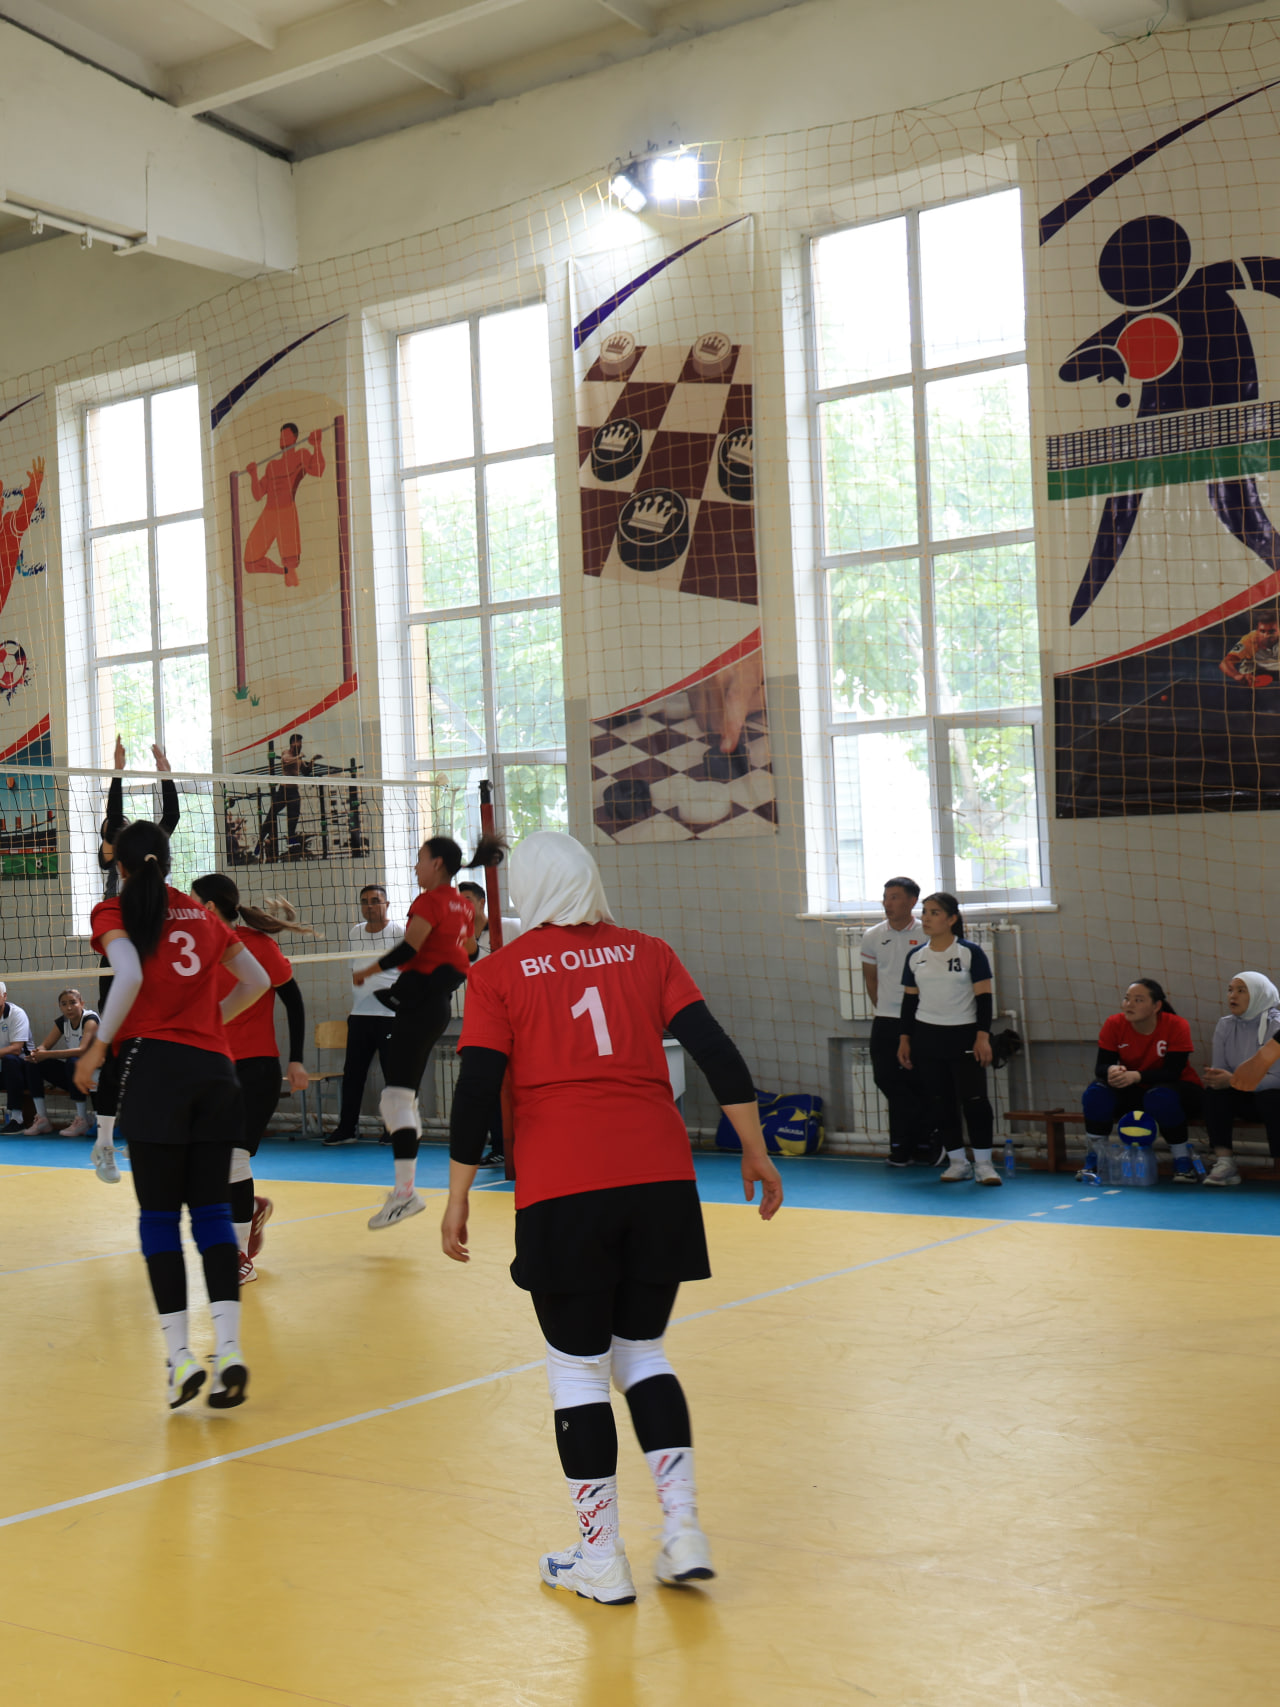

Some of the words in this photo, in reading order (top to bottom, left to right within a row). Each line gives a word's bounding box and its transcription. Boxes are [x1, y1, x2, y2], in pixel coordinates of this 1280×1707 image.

[168, 930, 201, 977] 3
[520, 954, 557, 977] ВК
[560, 944, 636, 970] ОШМУ
[947, 957, 962, 972] 13
[570, 986, 614, 1057] 1
[1156, 1040, 1168, 1057] 6
